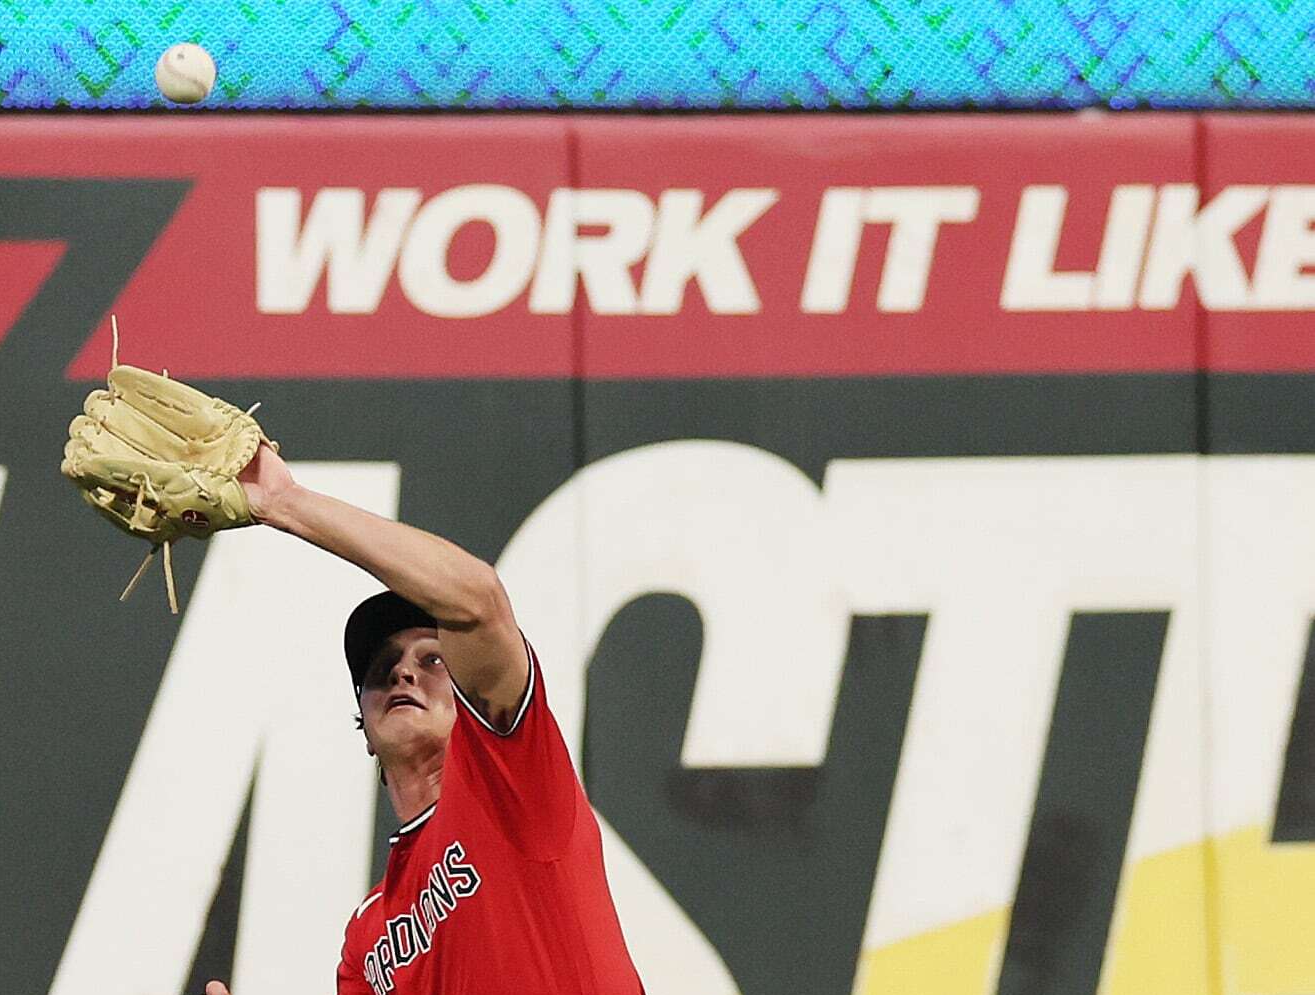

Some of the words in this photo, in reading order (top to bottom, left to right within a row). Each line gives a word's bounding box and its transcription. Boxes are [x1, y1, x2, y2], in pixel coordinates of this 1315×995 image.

[255, 183, 779, 318] WORK
[800, 185, 980, 313] IT
[999, 184, 1315, 313] LIKE
